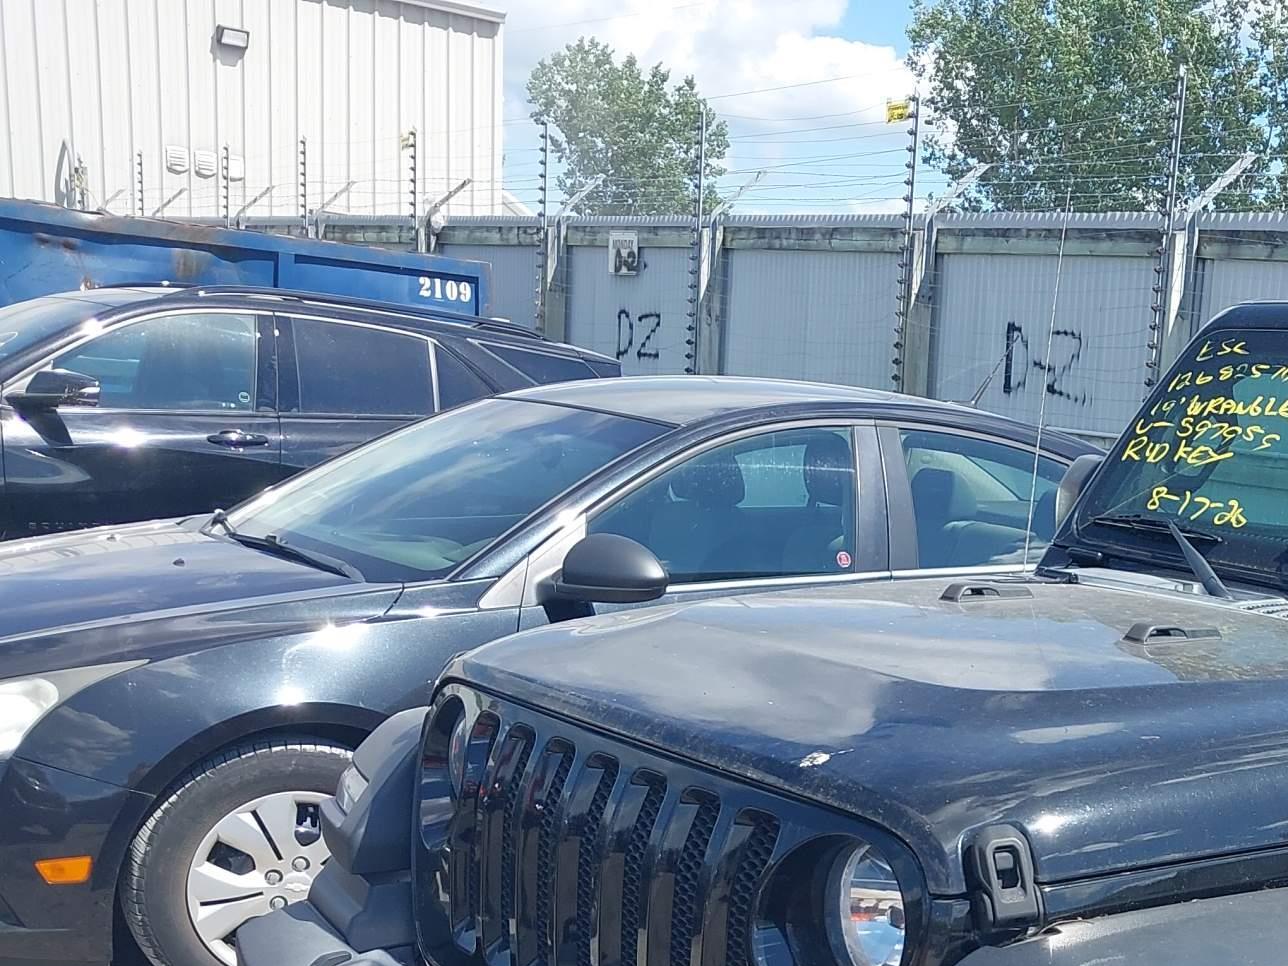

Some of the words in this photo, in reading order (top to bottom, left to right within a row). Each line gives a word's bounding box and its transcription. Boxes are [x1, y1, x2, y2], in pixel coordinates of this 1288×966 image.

[418, 276, 472, 302] 2109
[1173, 439, 1235, 468] KEY
[1146, 486, 1247, 528] 8-17-26
